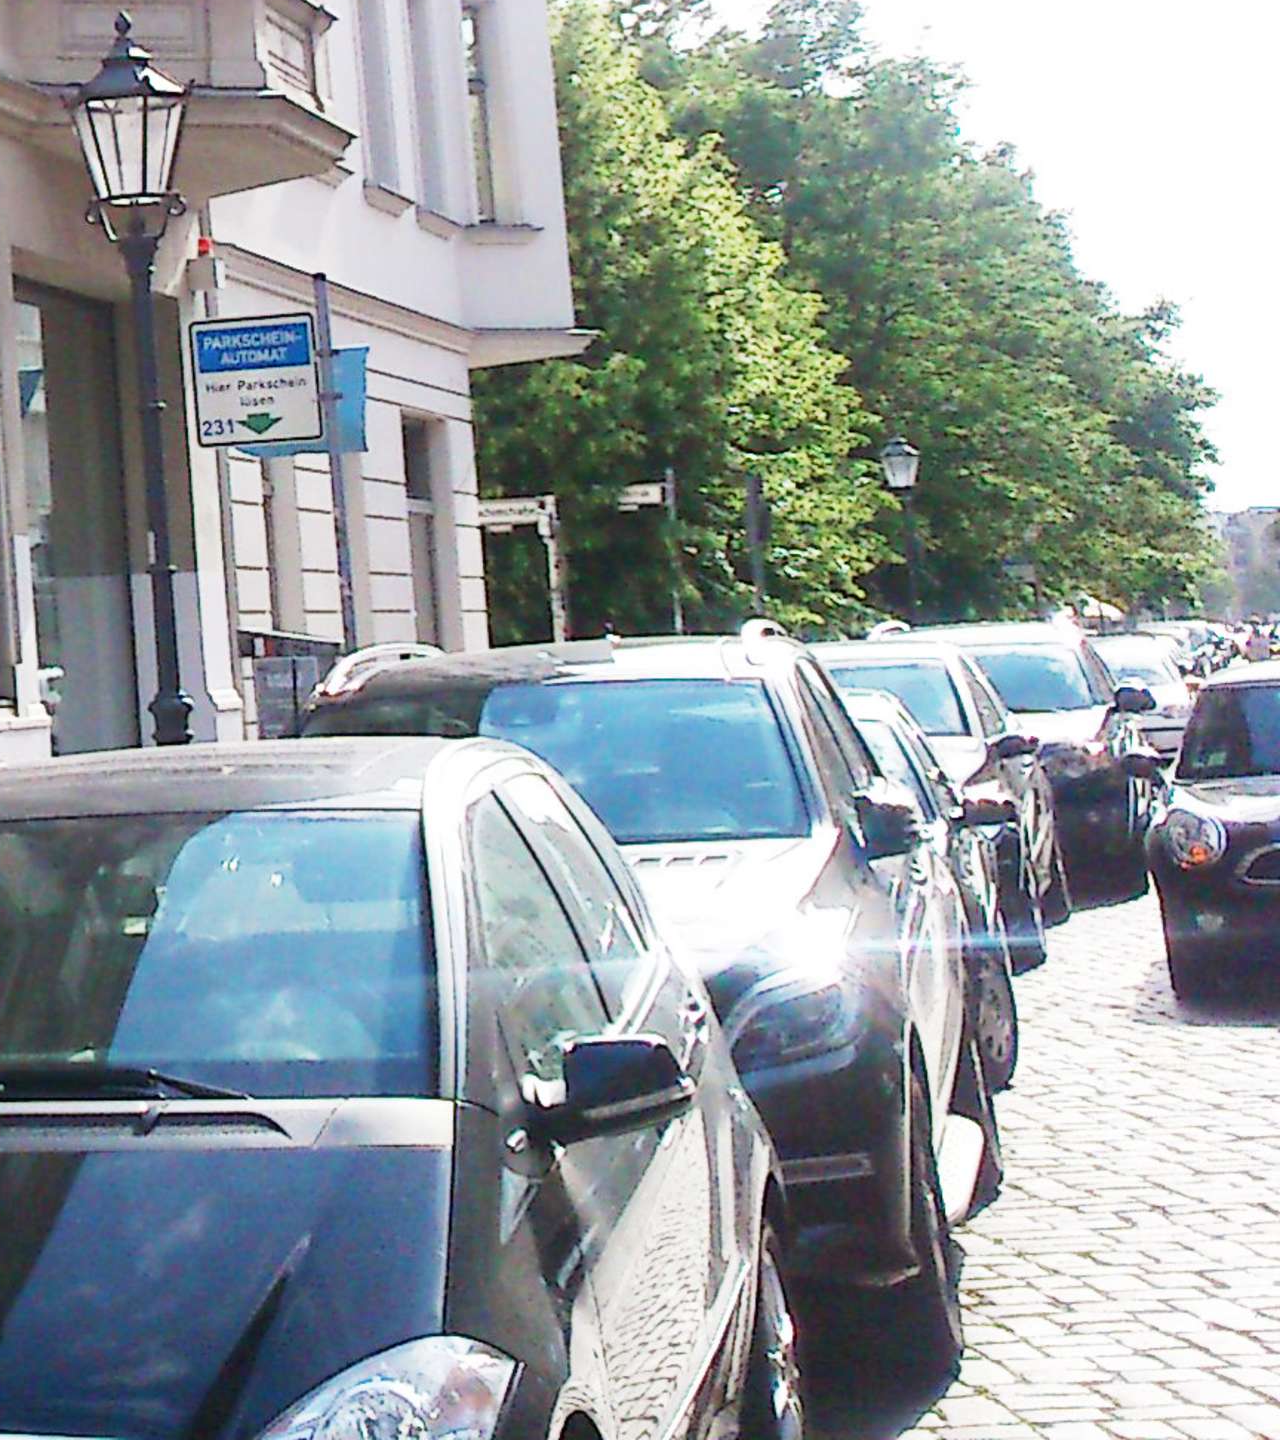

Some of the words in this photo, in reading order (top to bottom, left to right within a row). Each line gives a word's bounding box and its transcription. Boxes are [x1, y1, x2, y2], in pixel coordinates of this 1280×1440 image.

[203, 330, 303, 350] PARKSCHEIN-
[220, 347, 288, 365] AUTOMAT
[237, 378, 307, 391] Parkschein
[202, 419, 234, 436] 231
